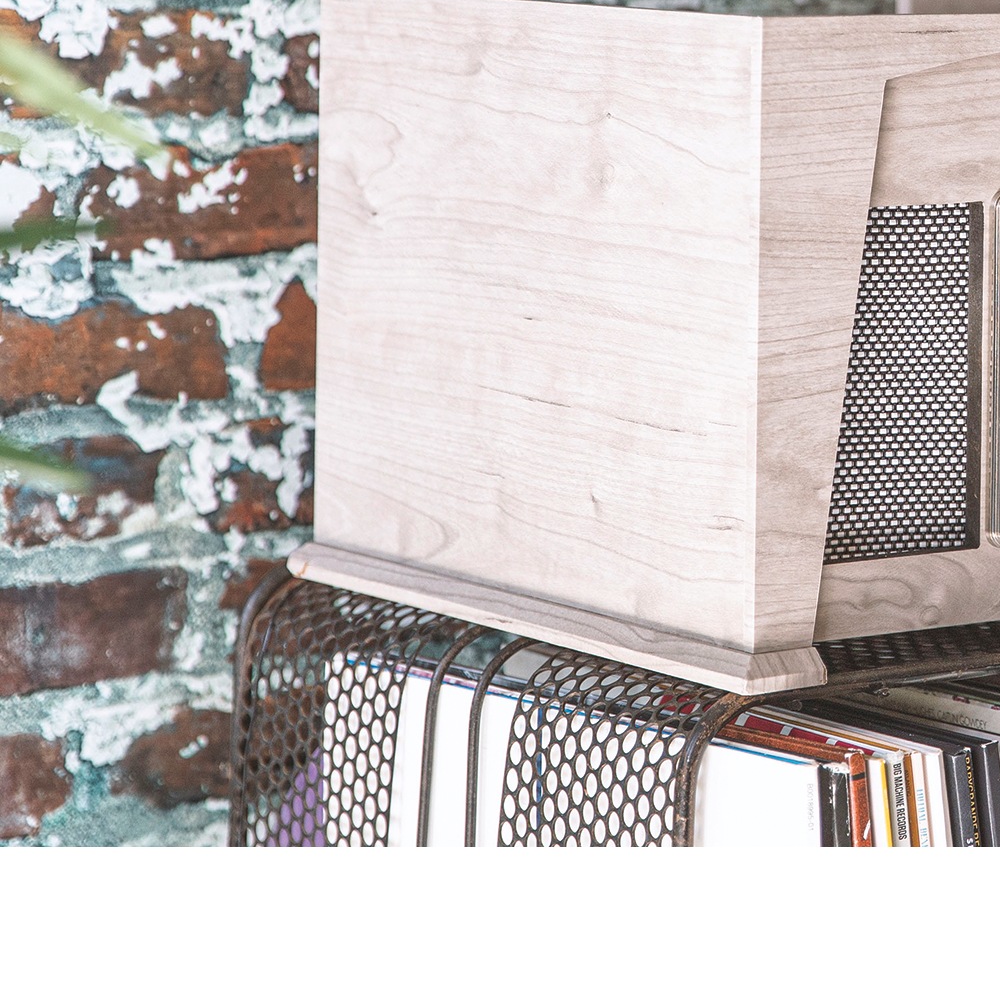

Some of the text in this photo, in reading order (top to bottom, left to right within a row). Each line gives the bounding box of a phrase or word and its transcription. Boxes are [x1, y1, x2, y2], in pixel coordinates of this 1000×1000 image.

[893, 762, 908, 841] BIG MACHINE RECORDS
